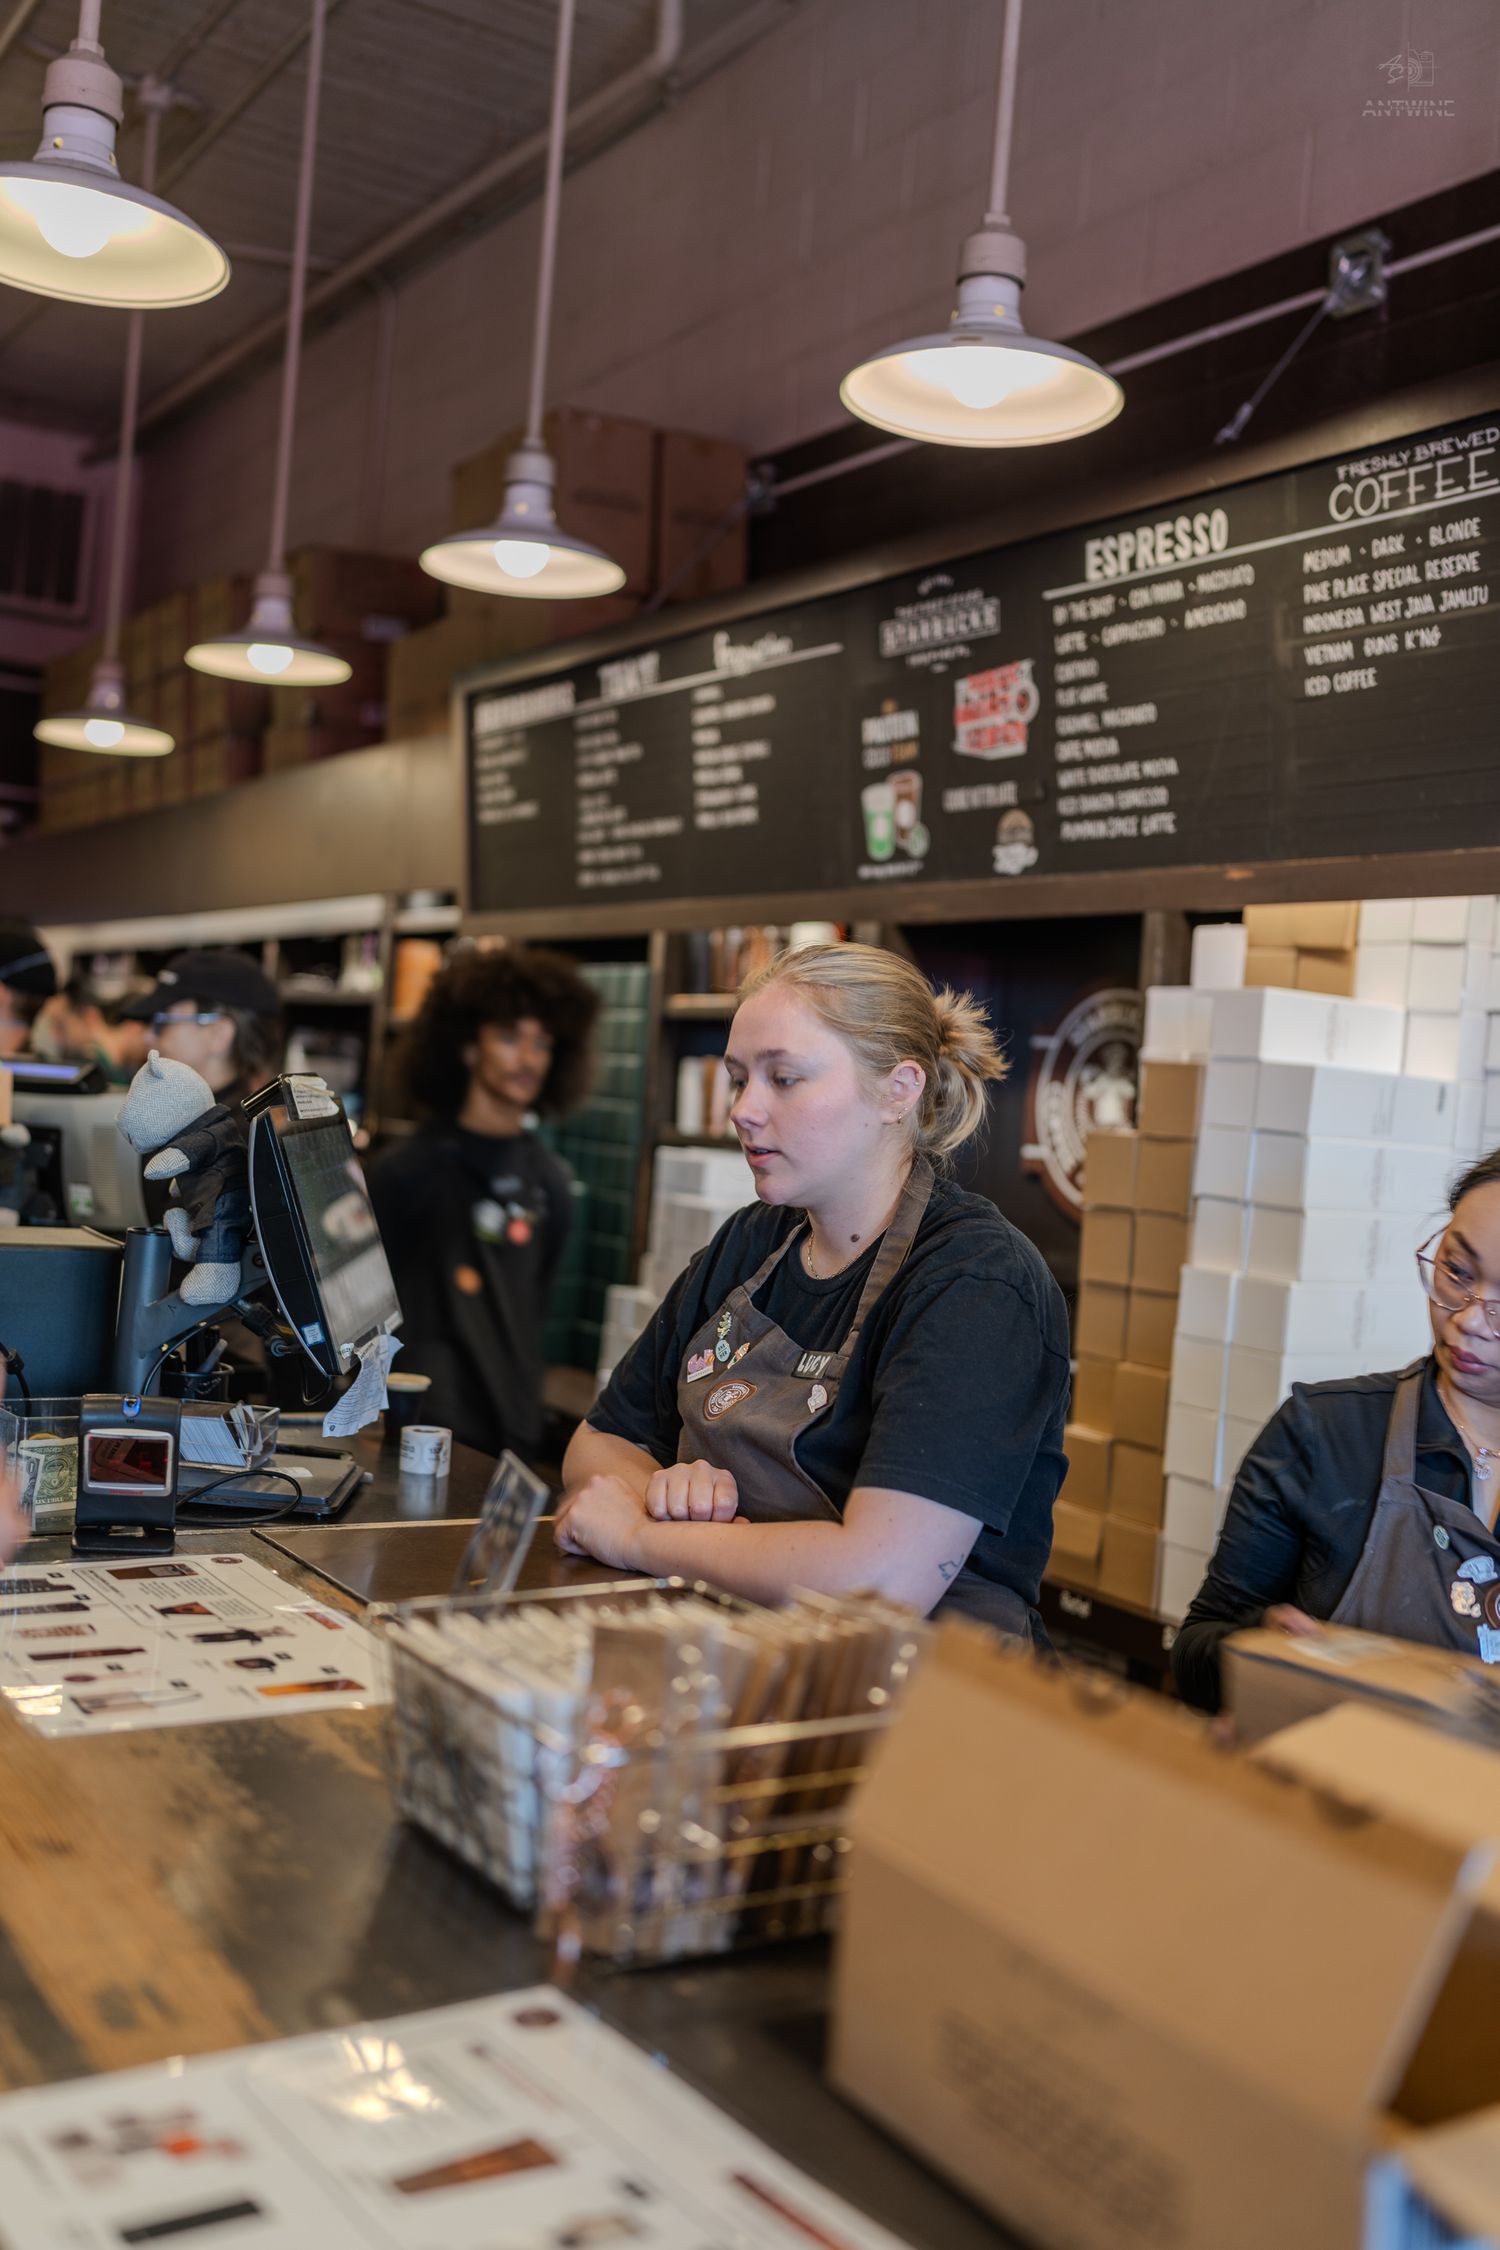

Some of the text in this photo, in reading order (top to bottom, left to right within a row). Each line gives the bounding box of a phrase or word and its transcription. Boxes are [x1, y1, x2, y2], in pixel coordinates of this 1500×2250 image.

[1336, 427, 1500, 481] FRESHLY BREWED
[1329, 447, 1500, 521] COFFEE
[1085, 508, 1228, 582] ESPRESSO
[1303, 516, 1482, 574] MEDIUM DARK BLONDE
[1303, 551, 1480, 604] PIKE PLACE SPECIAL RESERVE
[1054, 630, 1087, 655] LATTE
[1184, 597, 1247, 630] AMERICANO
[1303, 606, 1366, 634] INDONESIA
[1369, 598, 1403, 624] WEST
[1404, 593, 1435, 619] JAVA
[1303, 640, 1354, 666] VIETNAM
[1304, 667, 1377, 696] ICED COFFEE
[1140, 811, 1177, 836] LATTE
[797, 1352, 831, 1376] LUCY
